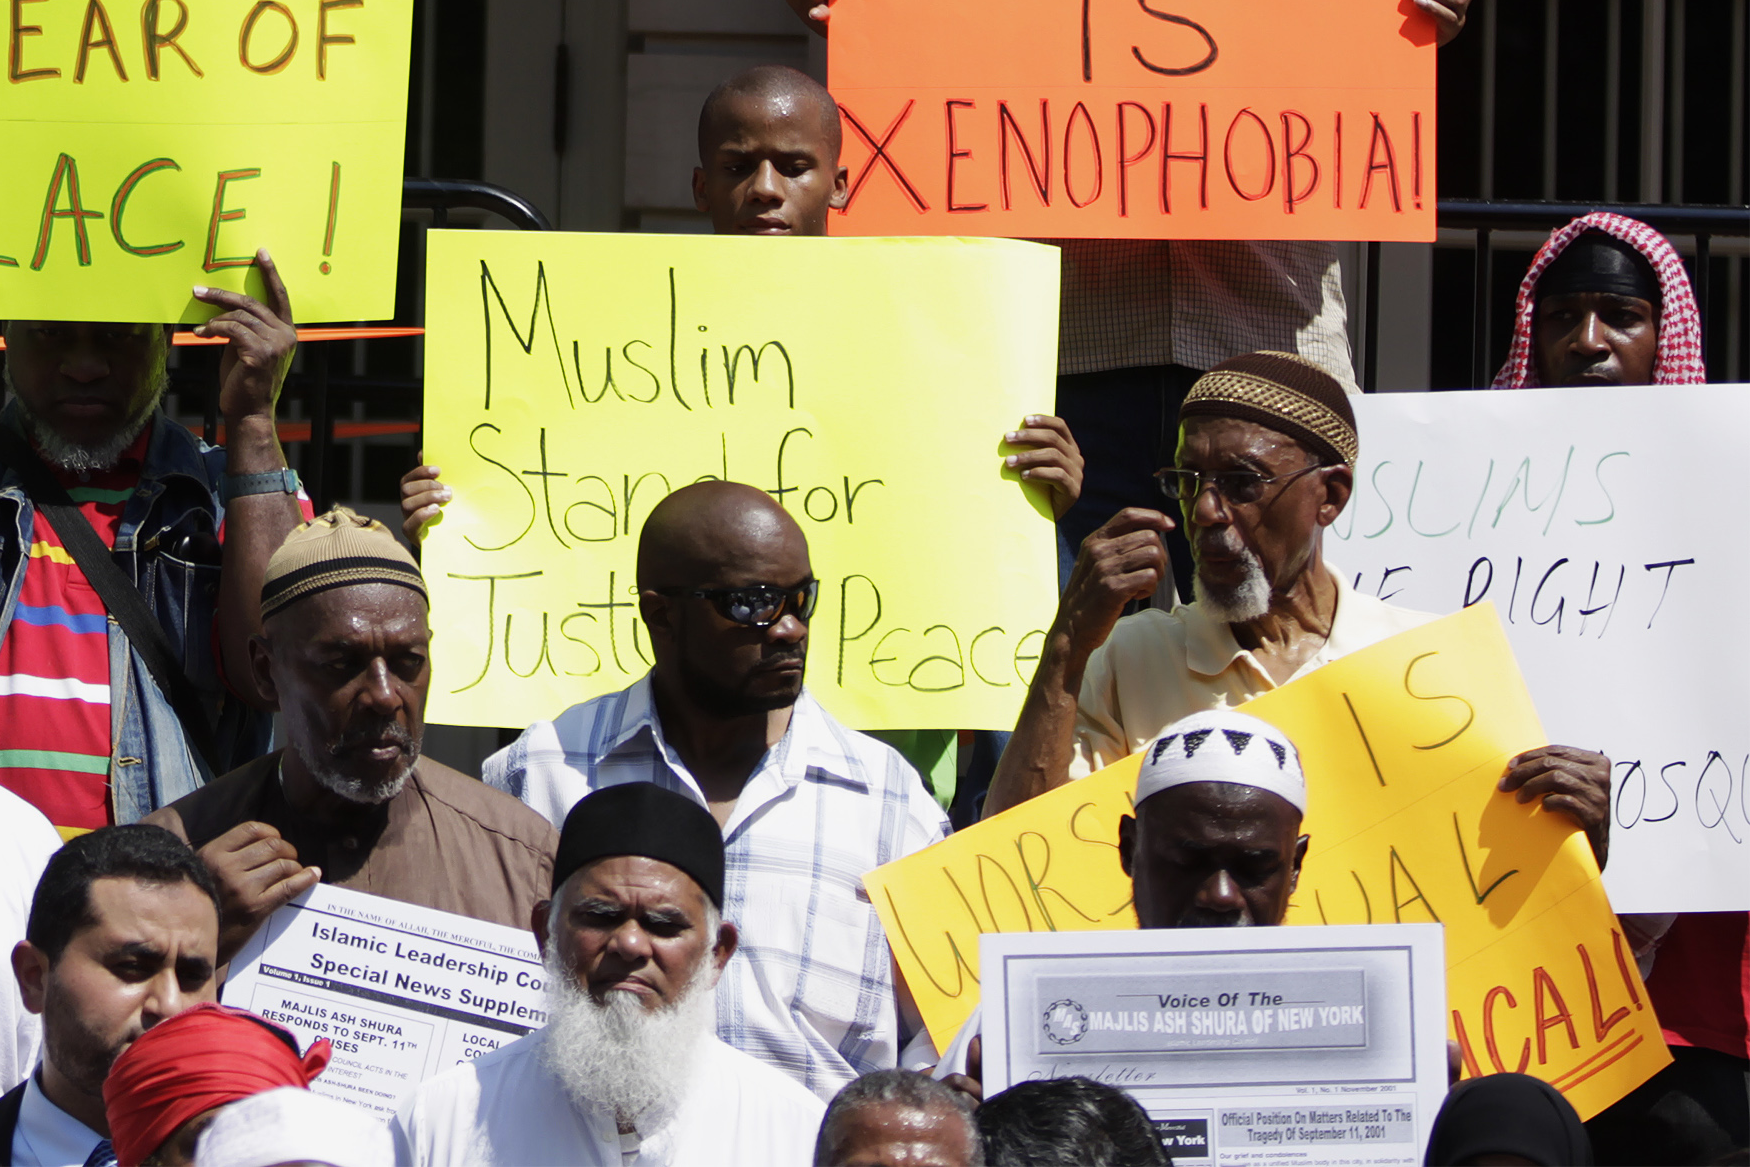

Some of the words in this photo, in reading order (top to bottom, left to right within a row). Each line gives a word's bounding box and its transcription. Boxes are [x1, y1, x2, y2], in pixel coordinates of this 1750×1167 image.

[836, 98, 1423, 217] XENOPHOBIA!
[480, 259, 795, 411] Muslim
[766, 426, 884, 524] for
[447, 570, 656, 694] Justi
[838, 574, 1050, 692] Peace
[1342, 650, 1474, 787] IS
[262, 966, 291, 979] Volume
[312, 922, 388, 954] Islamic
[394, 942, 509, 985] Leadership
[310, 953, 388, 985] Special
[394, 973, 452, 1000] News
[281, 999, 327, 1018] MAJLIS
[330, 1012, 356, 1025] ASH
[359, 1018, 403, 1036] SHURA
[1158, 994, 1210, 1008] Voice
[1217, 992, 1239, 1007] Of
[1248, 991, 1283, 1006] The
[262, 1009, 328, 1032] RESPONDS
[333, 1026, 349, 1037] TO
[353, 1031, 388, 1047] SEPT.
[1090, 1011, 1149, 1032] MAJLIS
[1153, 1011, 1187, 1034] ASH
[1191, 1010, 1248, 1036] SHURA
[1252, 1009, 1274, 1034] OF
[1278, 1007, 1314, 1032] NEW
[1318, 1005, 1364, 1027] YORK
[1221, 1112, 1254, 1127] Official
[1256, 1111, 1292, 1126] Position
[1294, 1110, 1307, 1125] On
[1310, 1109, 1343, 1125] Matters
[1345, 1108, 1381, 1124] Related
[1381, 1109, 1393, 1123] To
[1394, 1108, 1412, 1122] The
[1247, 1128, 1284, 1145] Tragedy
[1286, 1128, 1297, 1141] Of
[1299, 1126, 1346, 1144] September
[1365, 1125, 1386, 1139] 2001
[1177, 1135, 1206, 1146] York
